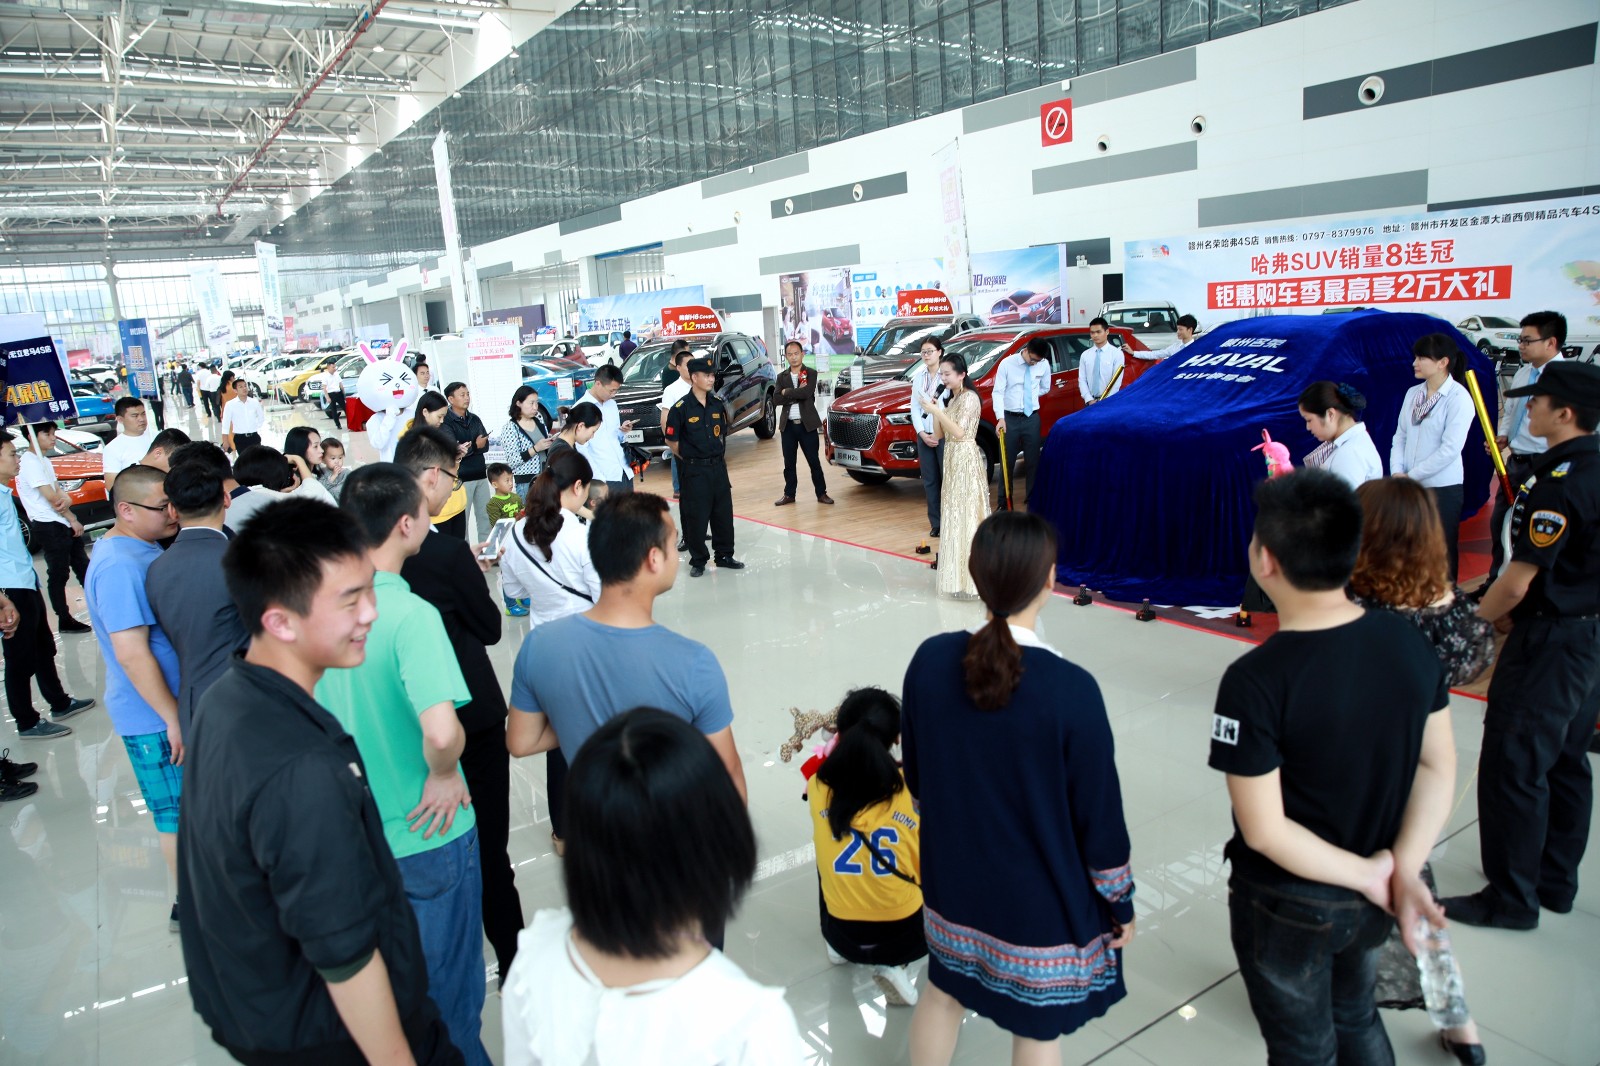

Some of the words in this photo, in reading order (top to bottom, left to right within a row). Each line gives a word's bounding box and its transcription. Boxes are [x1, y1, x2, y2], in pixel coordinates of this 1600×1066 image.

[1251, 239, 1455, 276] 哈弗SUV销量8连冠
[1215, 266, 1500, 307] 钜惠购车季最高享2万大礼
[1178, 352, 1288, 373] HAVAL
[833, 826, 900, 877] 26
